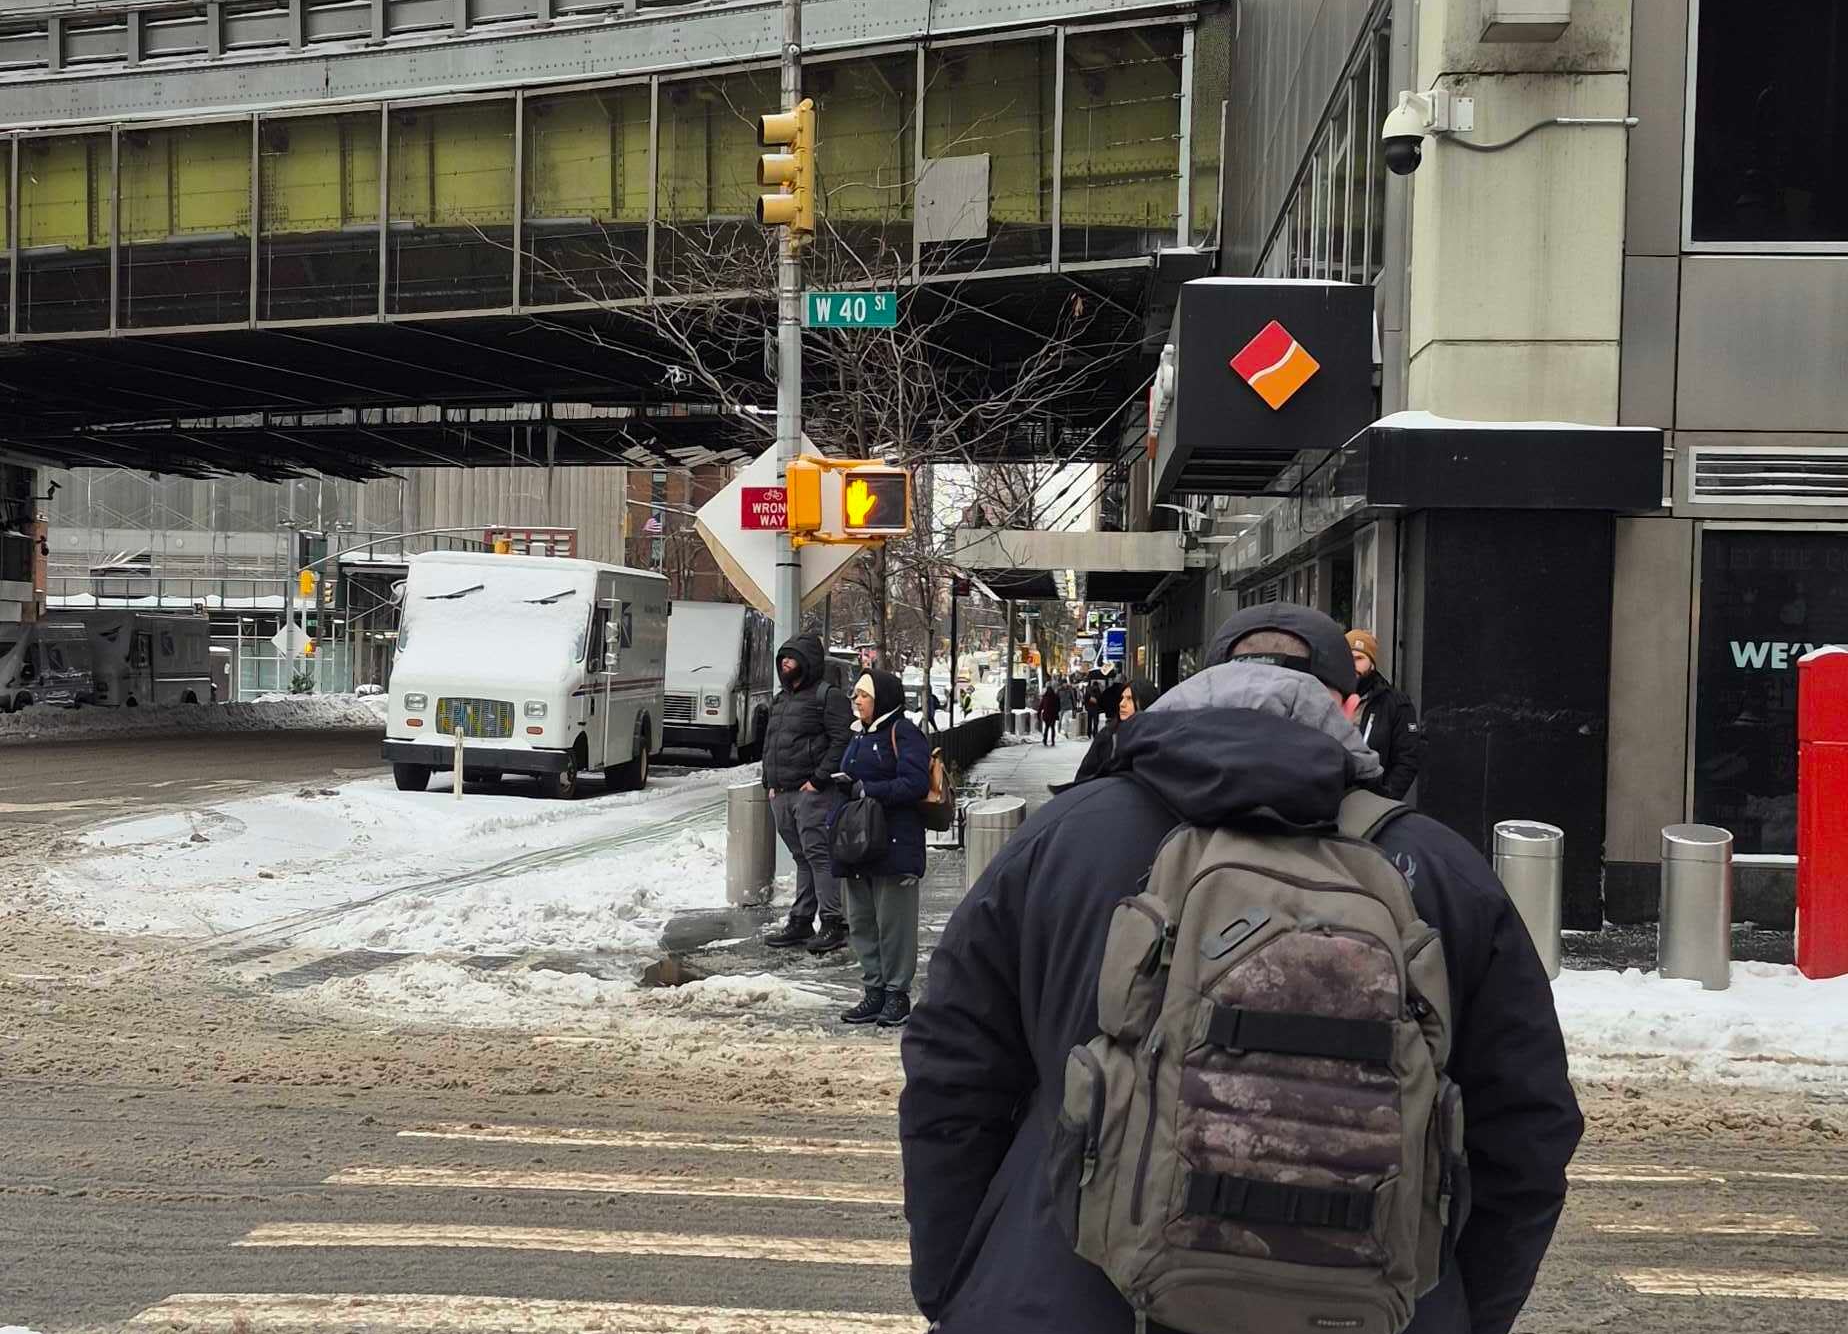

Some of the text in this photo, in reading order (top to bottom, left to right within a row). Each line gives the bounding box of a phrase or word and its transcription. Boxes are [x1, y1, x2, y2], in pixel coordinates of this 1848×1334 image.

[815, 295, 887, 323] W 40 St
[751, 502, 786, 514] WRON
[759, 514, 786, 526] WAY
